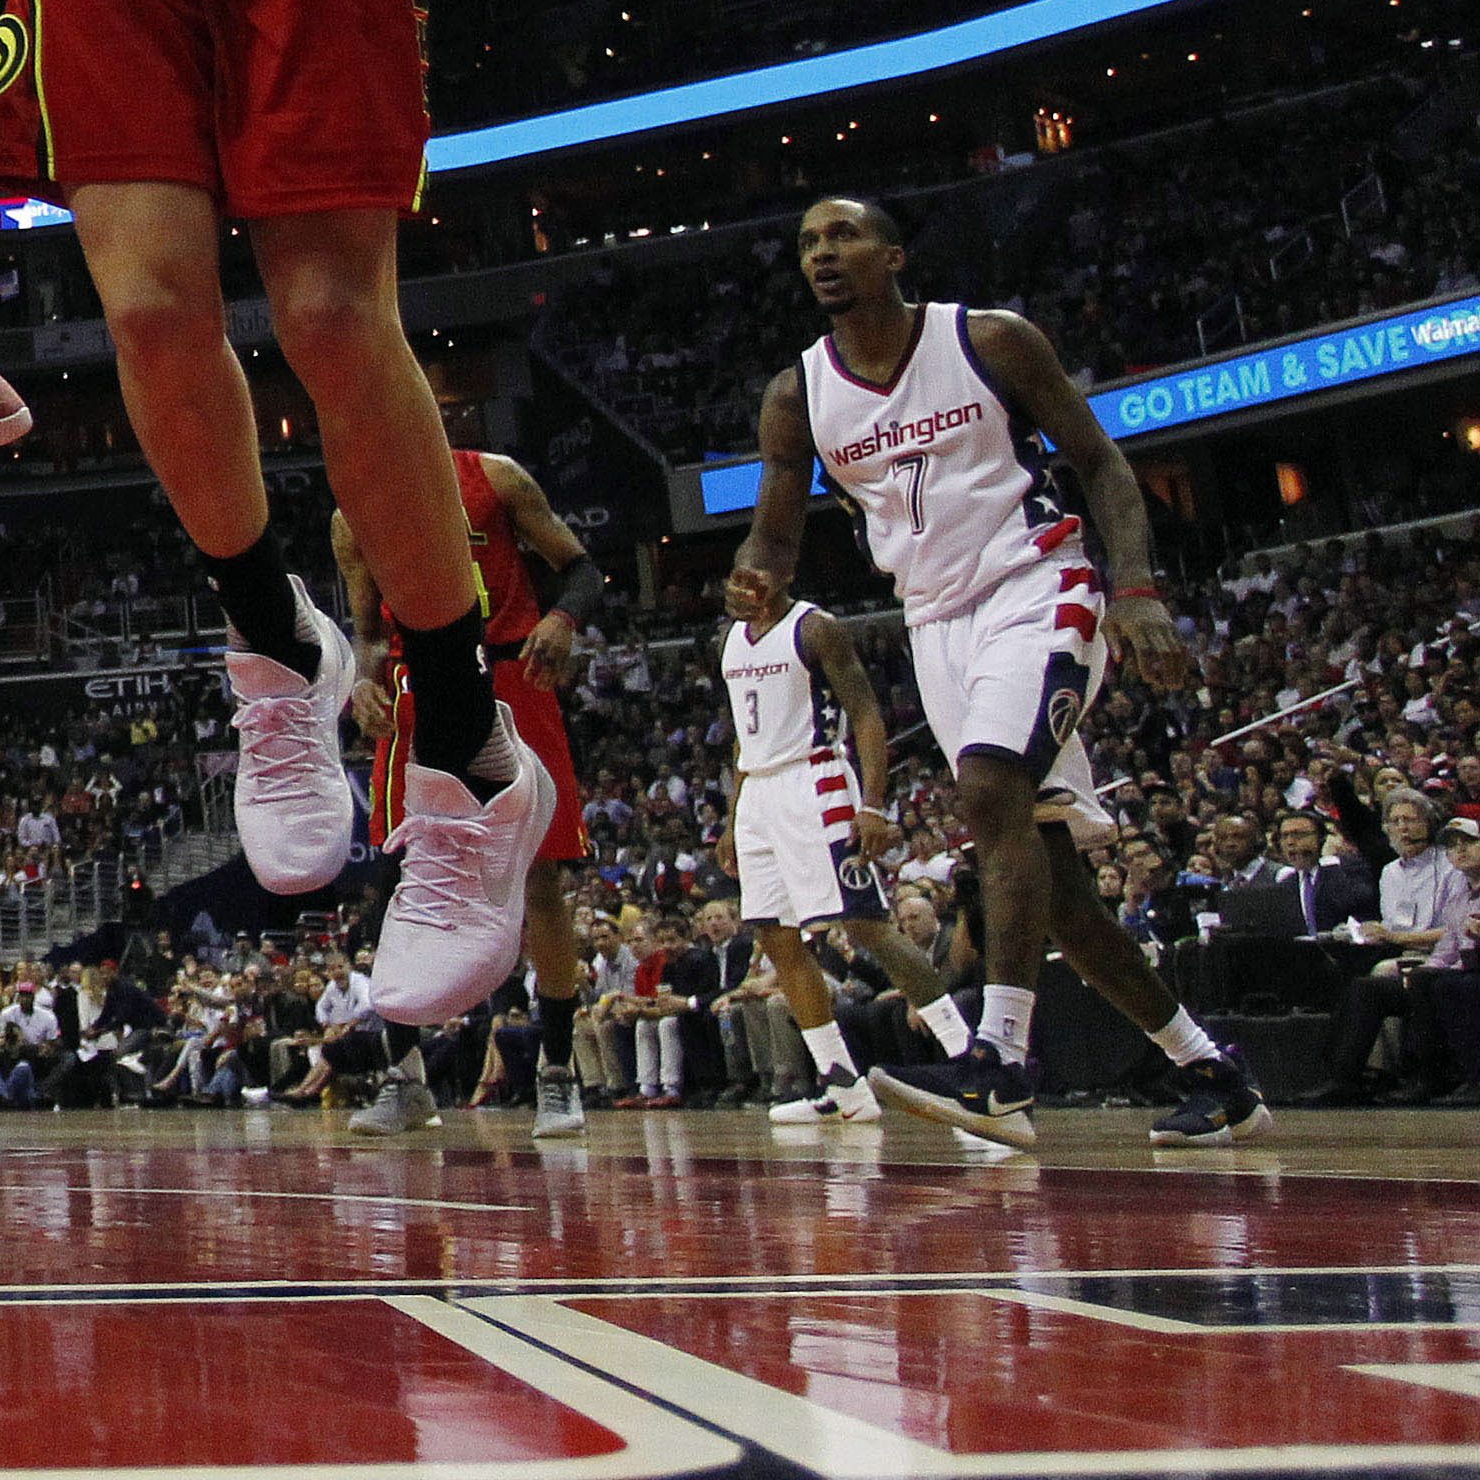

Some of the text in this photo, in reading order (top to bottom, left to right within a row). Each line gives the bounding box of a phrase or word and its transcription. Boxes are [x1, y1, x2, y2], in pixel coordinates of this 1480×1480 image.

[1118, 385, 1175, 429] GO
[1177, 358, 1272, 414] TEAM
[1281, 351, 1308, 388] &
[1316, 323, 1411, 380] SAVE
[891, 451, 931, 535] 7
[744, 690, 759, 735] 3
